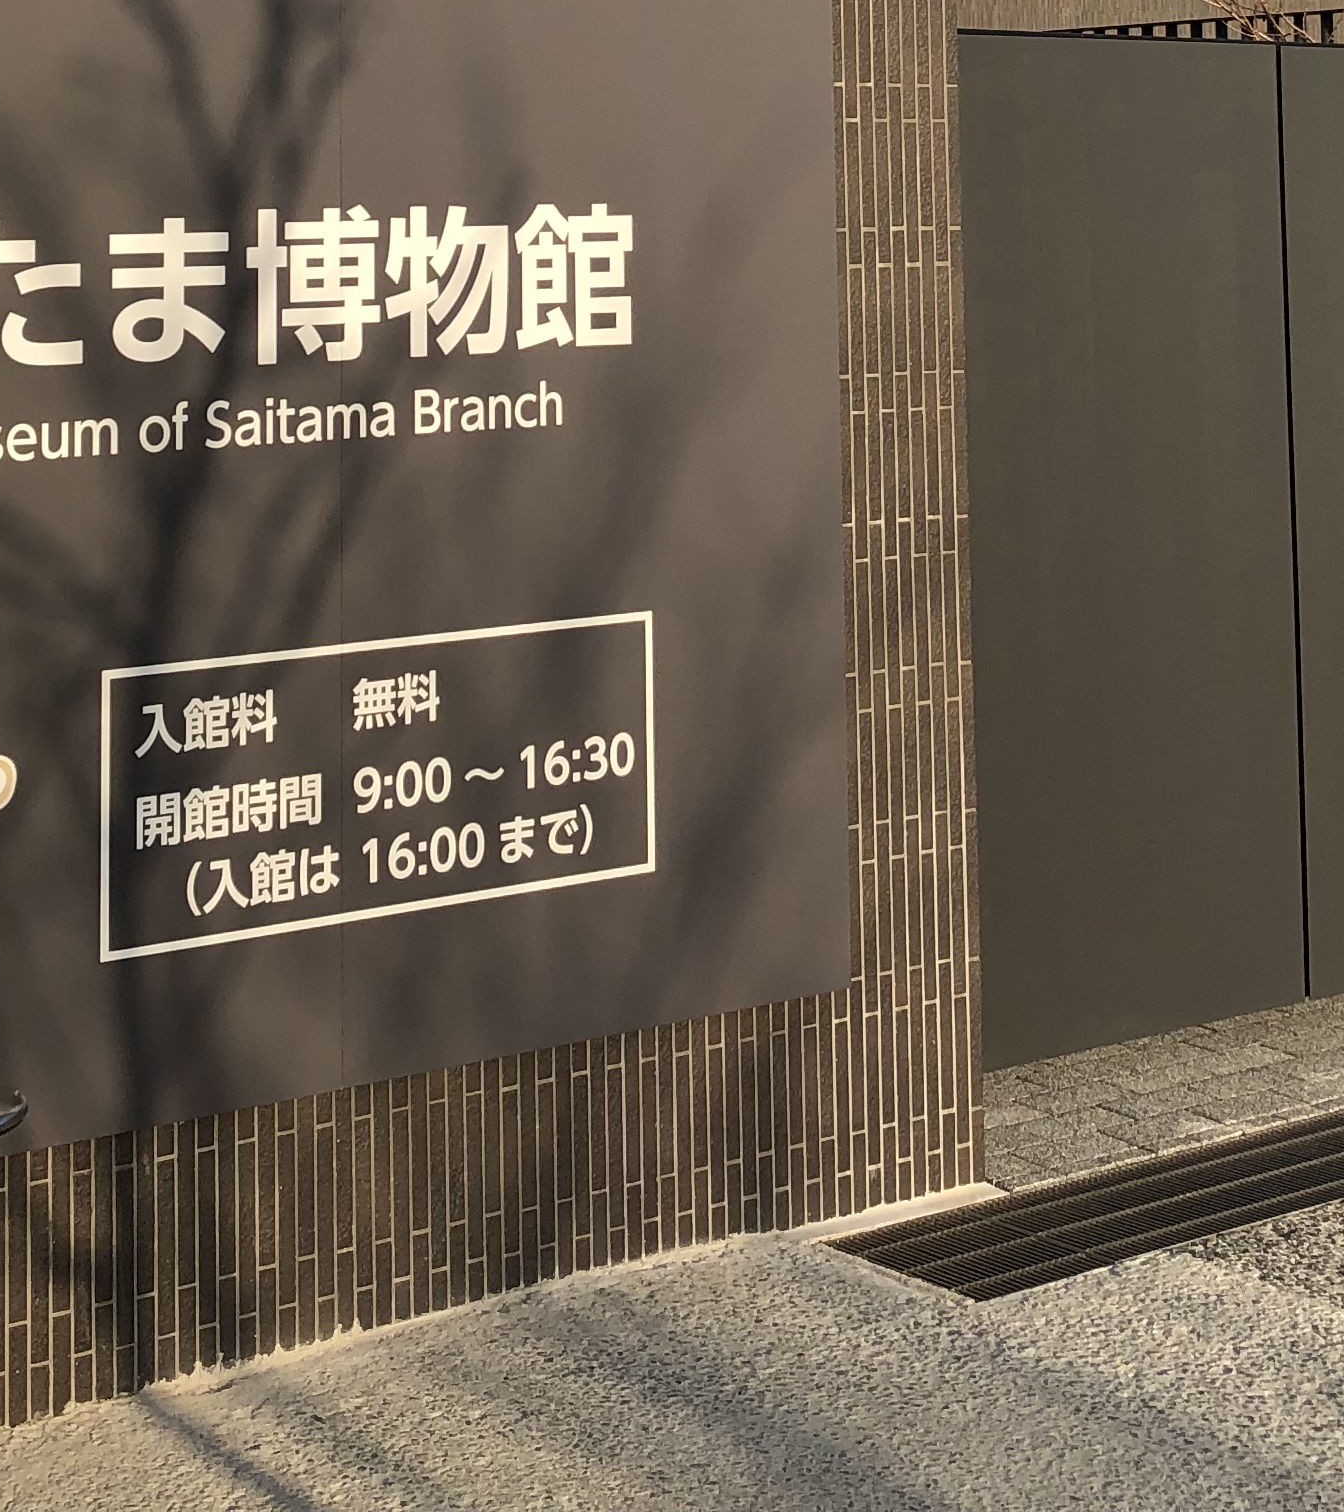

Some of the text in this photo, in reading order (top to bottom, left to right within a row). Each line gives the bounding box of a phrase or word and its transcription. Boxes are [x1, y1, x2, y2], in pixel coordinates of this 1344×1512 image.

[139, 400, 188, 452] of
[205, 397, 395, 449] Saitama
[414, 381, 562, 435] Branch
[135, 669, 441, 758] 入館料 無料
[136, 772, 323, 850] 開館時間
[354, 757, 452, 814] 9:00
[520, 731, 635, 790] 16:30
[186, 804, 594, 916] (入館は 16:00 まで)
